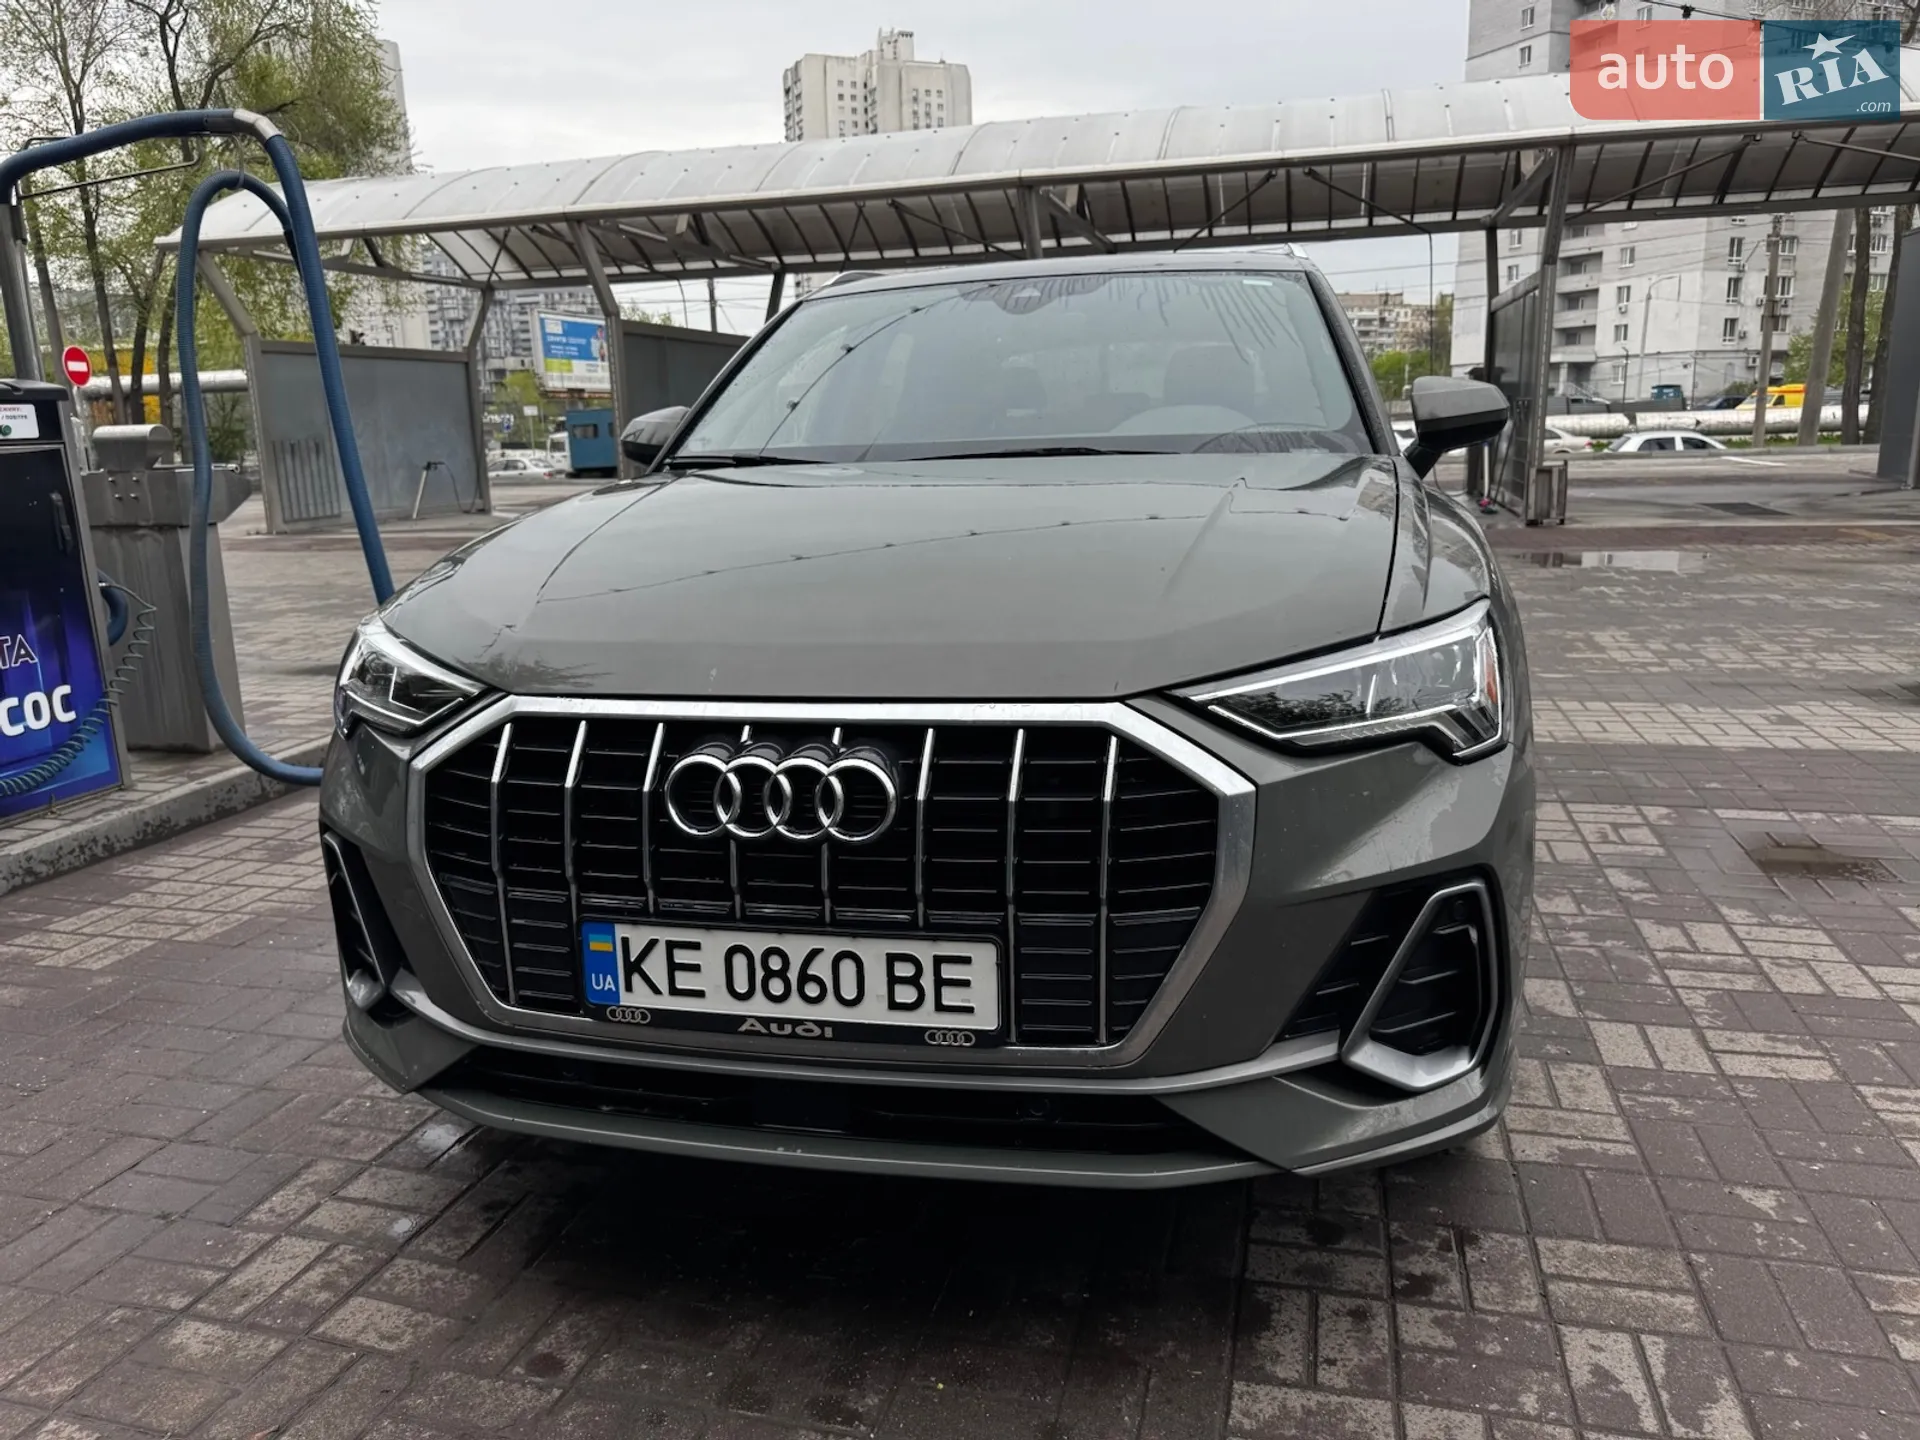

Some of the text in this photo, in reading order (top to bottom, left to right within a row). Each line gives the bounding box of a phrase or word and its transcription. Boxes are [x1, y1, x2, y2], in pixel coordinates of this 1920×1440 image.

[591, 973, 616, 992] UA
[620, 936, 975, 1014] KE 0860 BE
[737, 1017, 833, 1038] Audi
